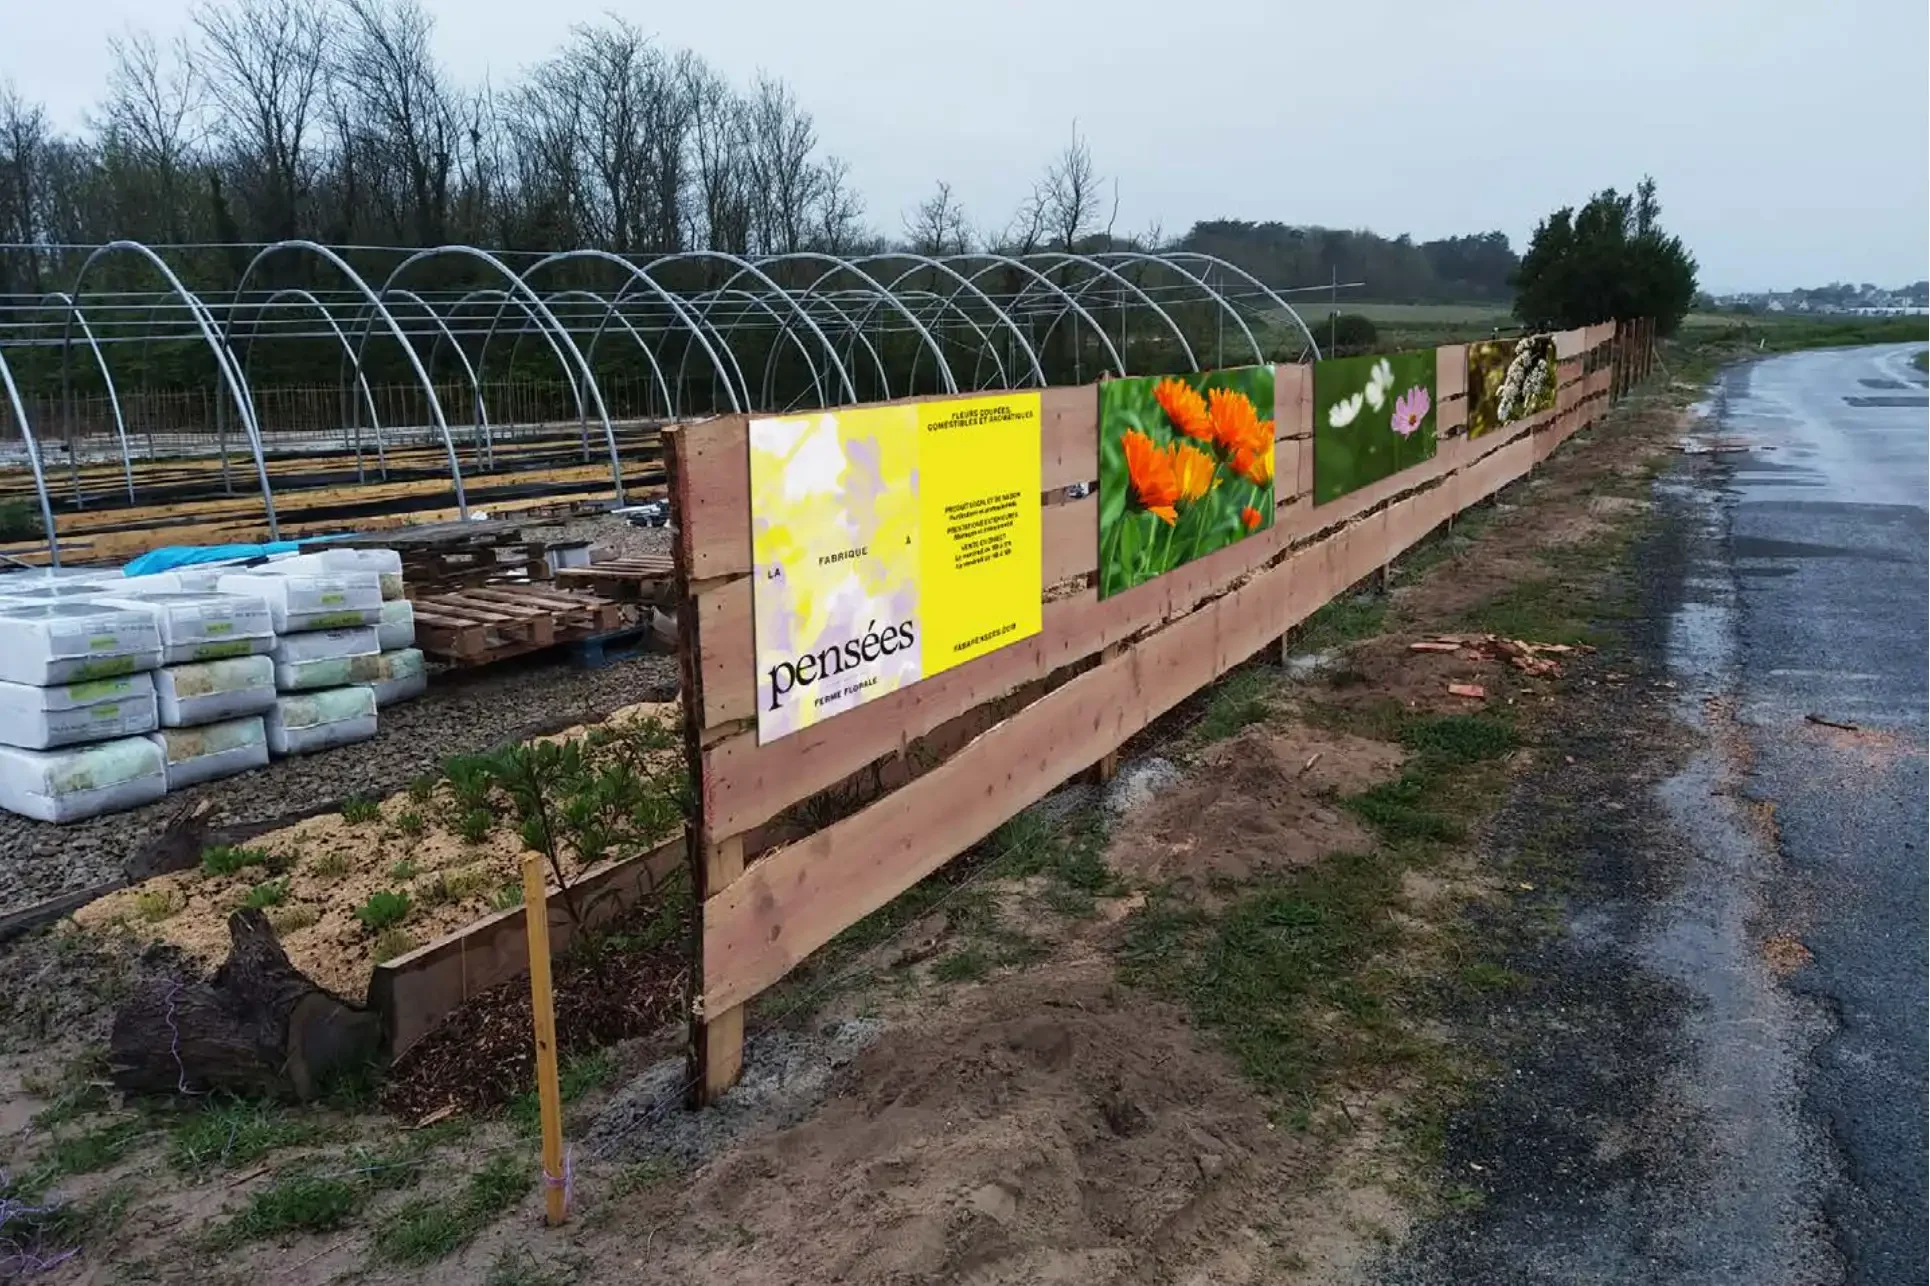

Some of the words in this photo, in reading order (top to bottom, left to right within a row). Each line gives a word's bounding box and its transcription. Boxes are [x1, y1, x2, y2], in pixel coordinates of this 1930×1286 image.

[767, 567, 781, 580] LA
[818, 547, 868, 565] FABRIQUE
[768, 619, 914, 712] pensées
[814, 690, 842, 707] FERME
[844, 676, 878, 698] FLORALE
